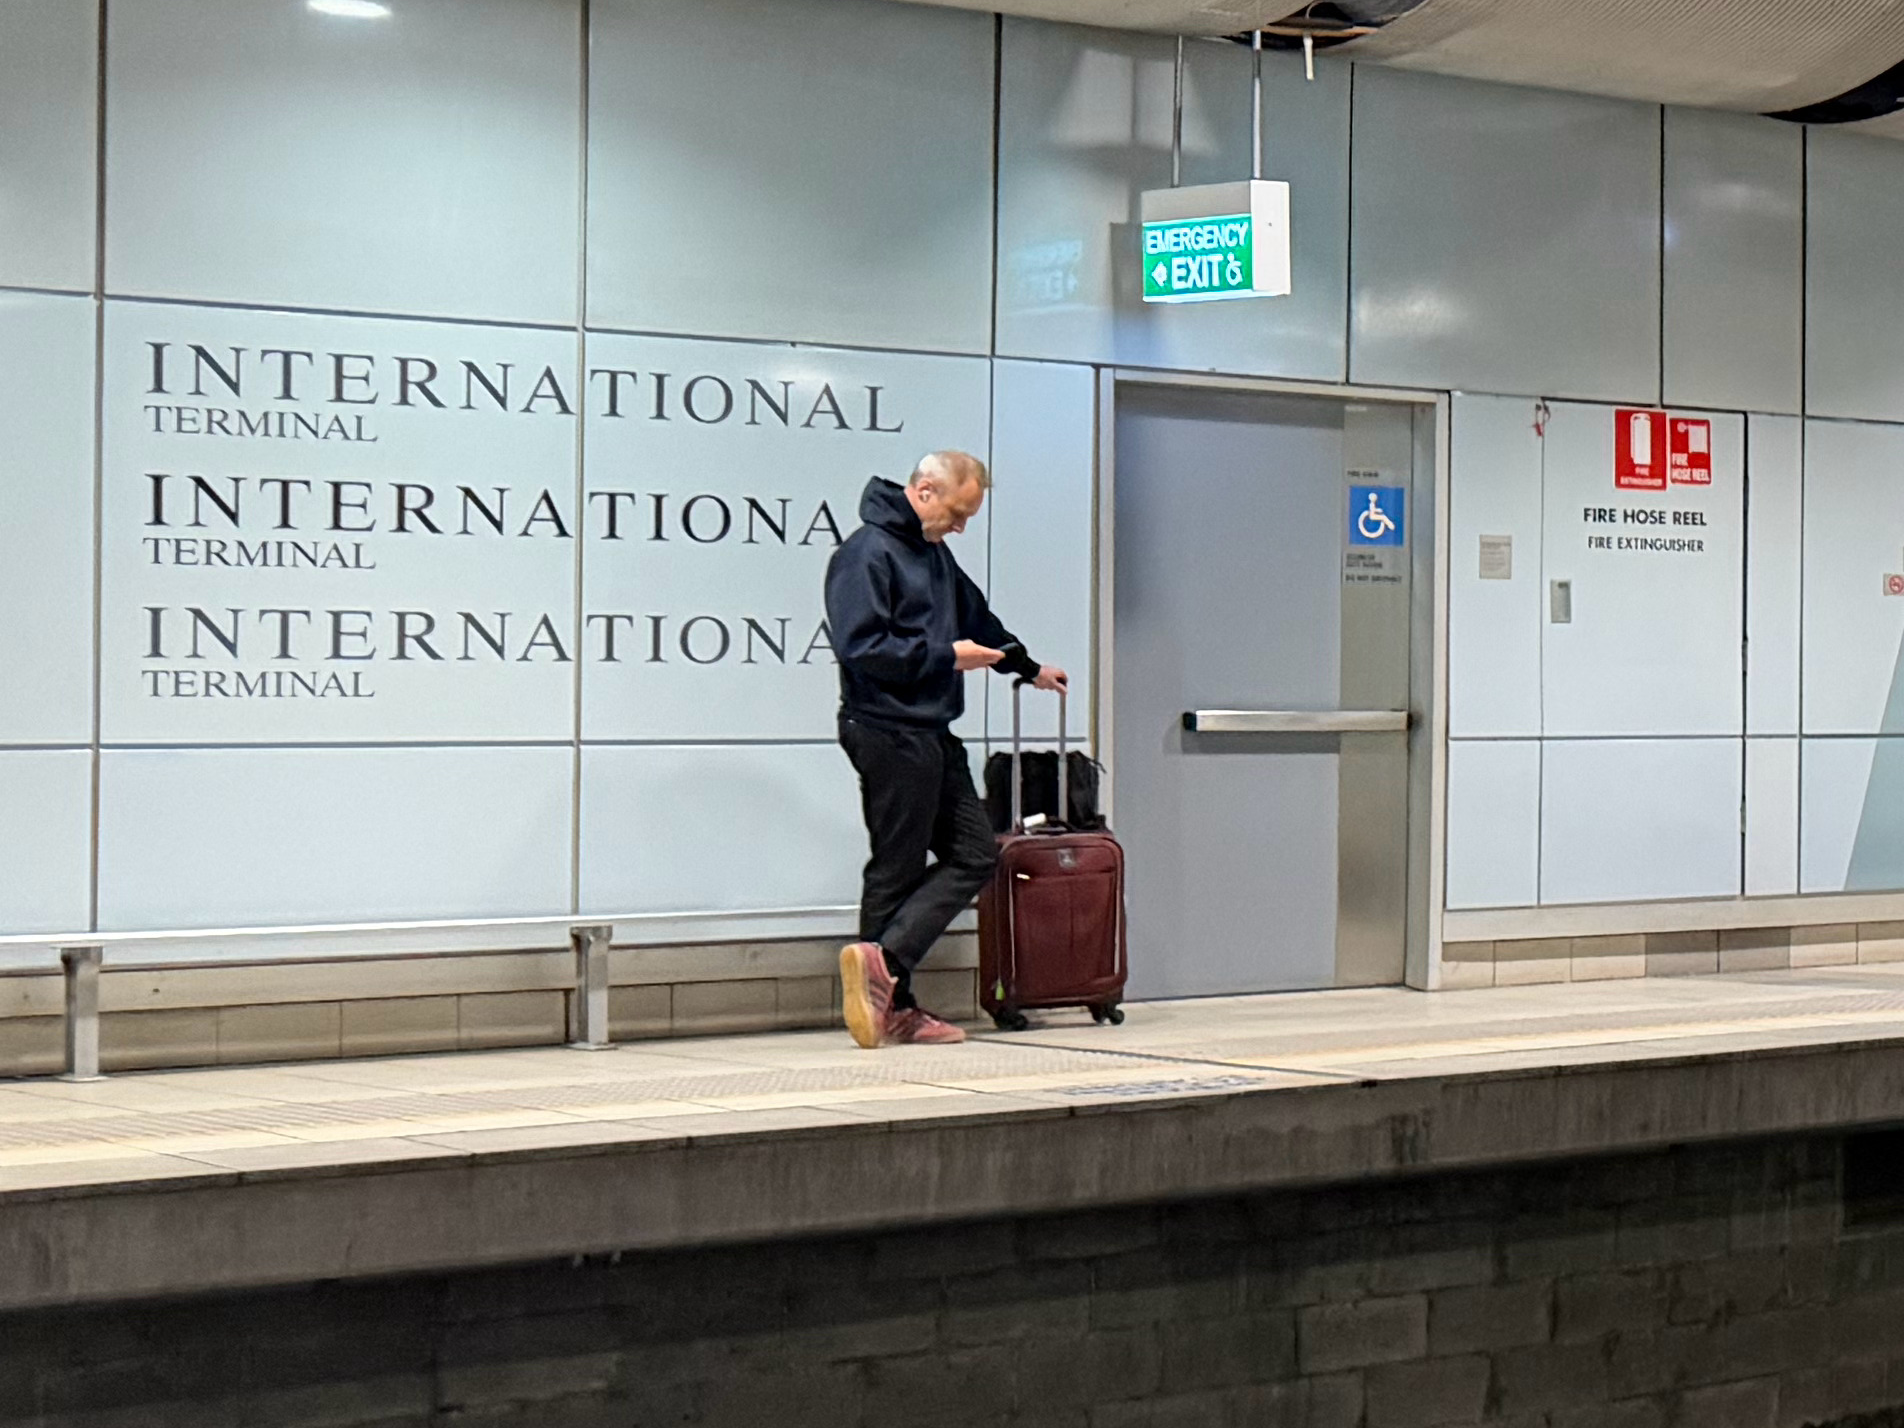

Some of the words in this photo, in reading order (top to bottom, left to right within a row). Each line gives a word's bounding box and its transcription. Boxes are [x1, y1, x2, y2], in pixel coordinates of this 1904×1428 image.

[1146, 222, 1248, 255] EMERGENCY
[1172, 254, 1224, 290] EXIT
[145, 341, 905, 434] INTERNATIONAL
[143, 405, 379, 443] TERMINAL
[143, 473, 843, 547] INTERNATIONA
[1583, 507, 1617, 523] FIRE
[1623, 508, 1667, 525] HOSE
[1672, 510, 1708, 527] REEL
[142, 537, 377, 570] TERMINAL
[1588, 536, 1612, 550] FIRE
[1617, 537, 1705, 552] EXTINGUISHER
[141, 606, 841, 666] INTERNATIONA
[141, 669, 376, 698] TERMINAL
